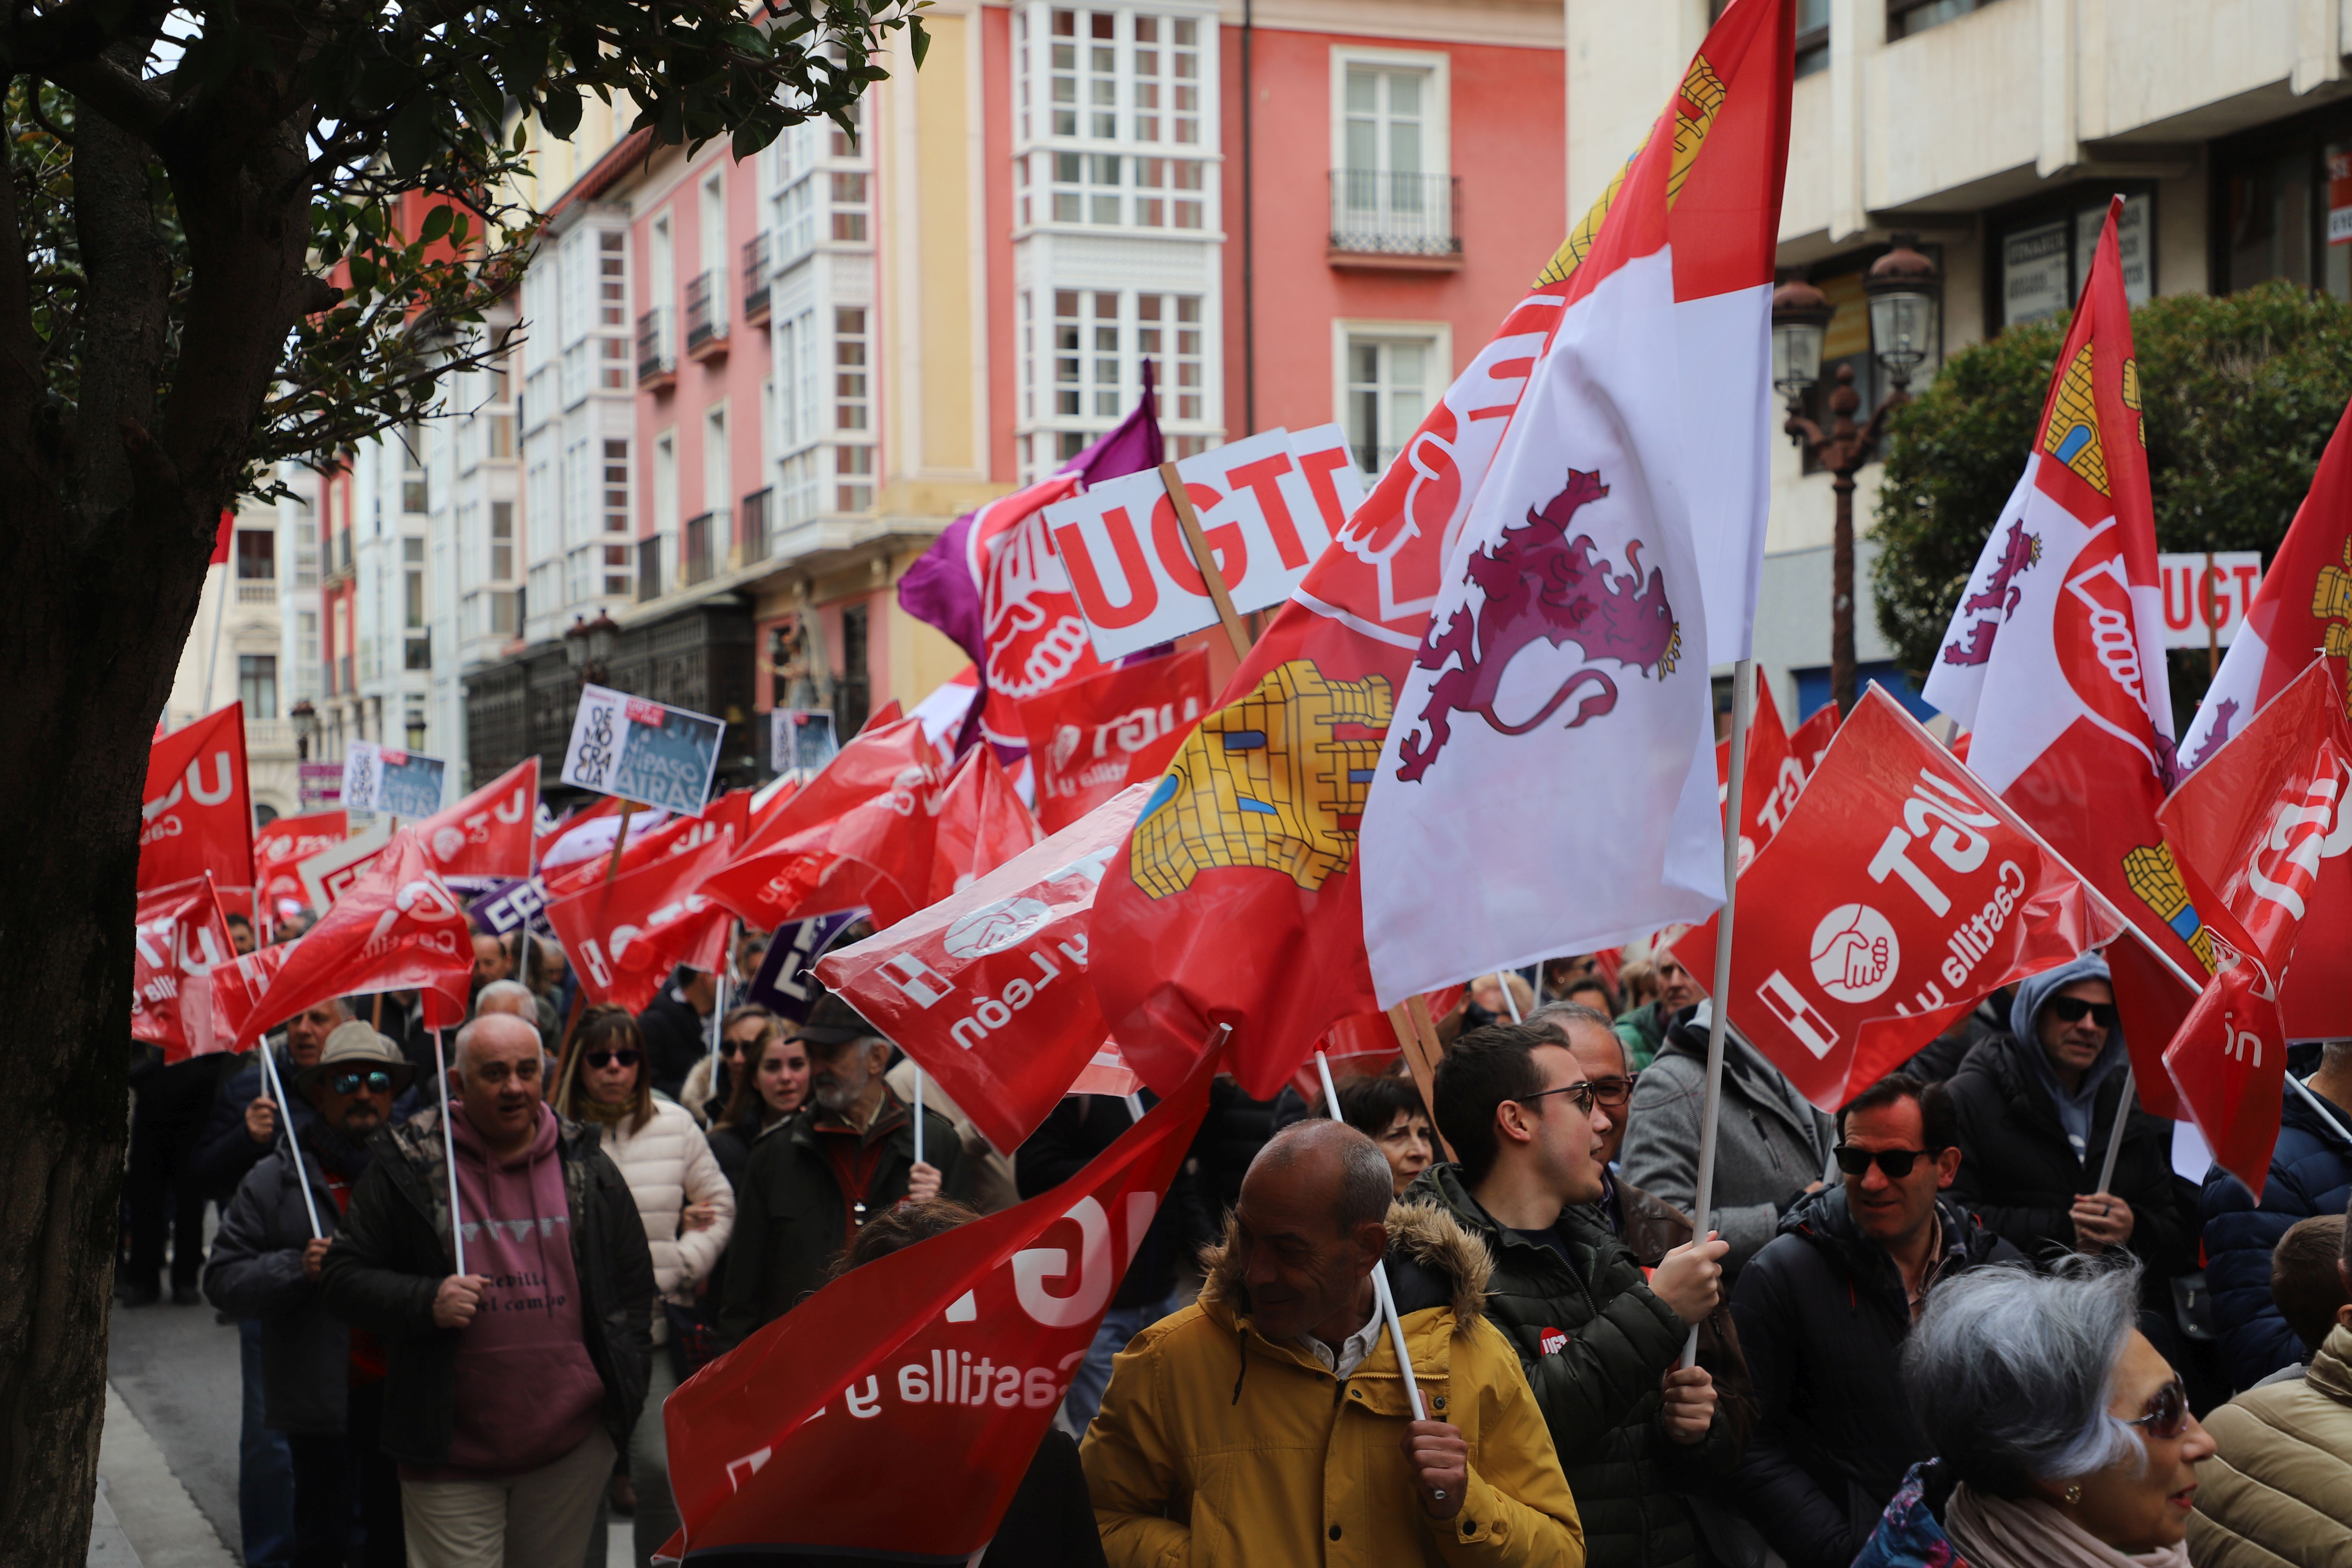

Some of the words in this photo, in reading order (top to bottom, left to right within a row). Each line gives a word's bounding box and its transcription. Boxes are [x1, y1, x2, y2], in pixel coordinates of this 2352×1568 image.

[1054, 452, 1310, 629] UGT
[2163, 565, 2259, 632] UGT
[592, 706, 614, 726] DE
[584, 727, 612, 747] MO
[579, 743, 612, 774] CRA
[643, 751, 699, 784] PASO
[573, 764, 602, 786] CIA
[1541, 1334, 1568, 1354] UGT
